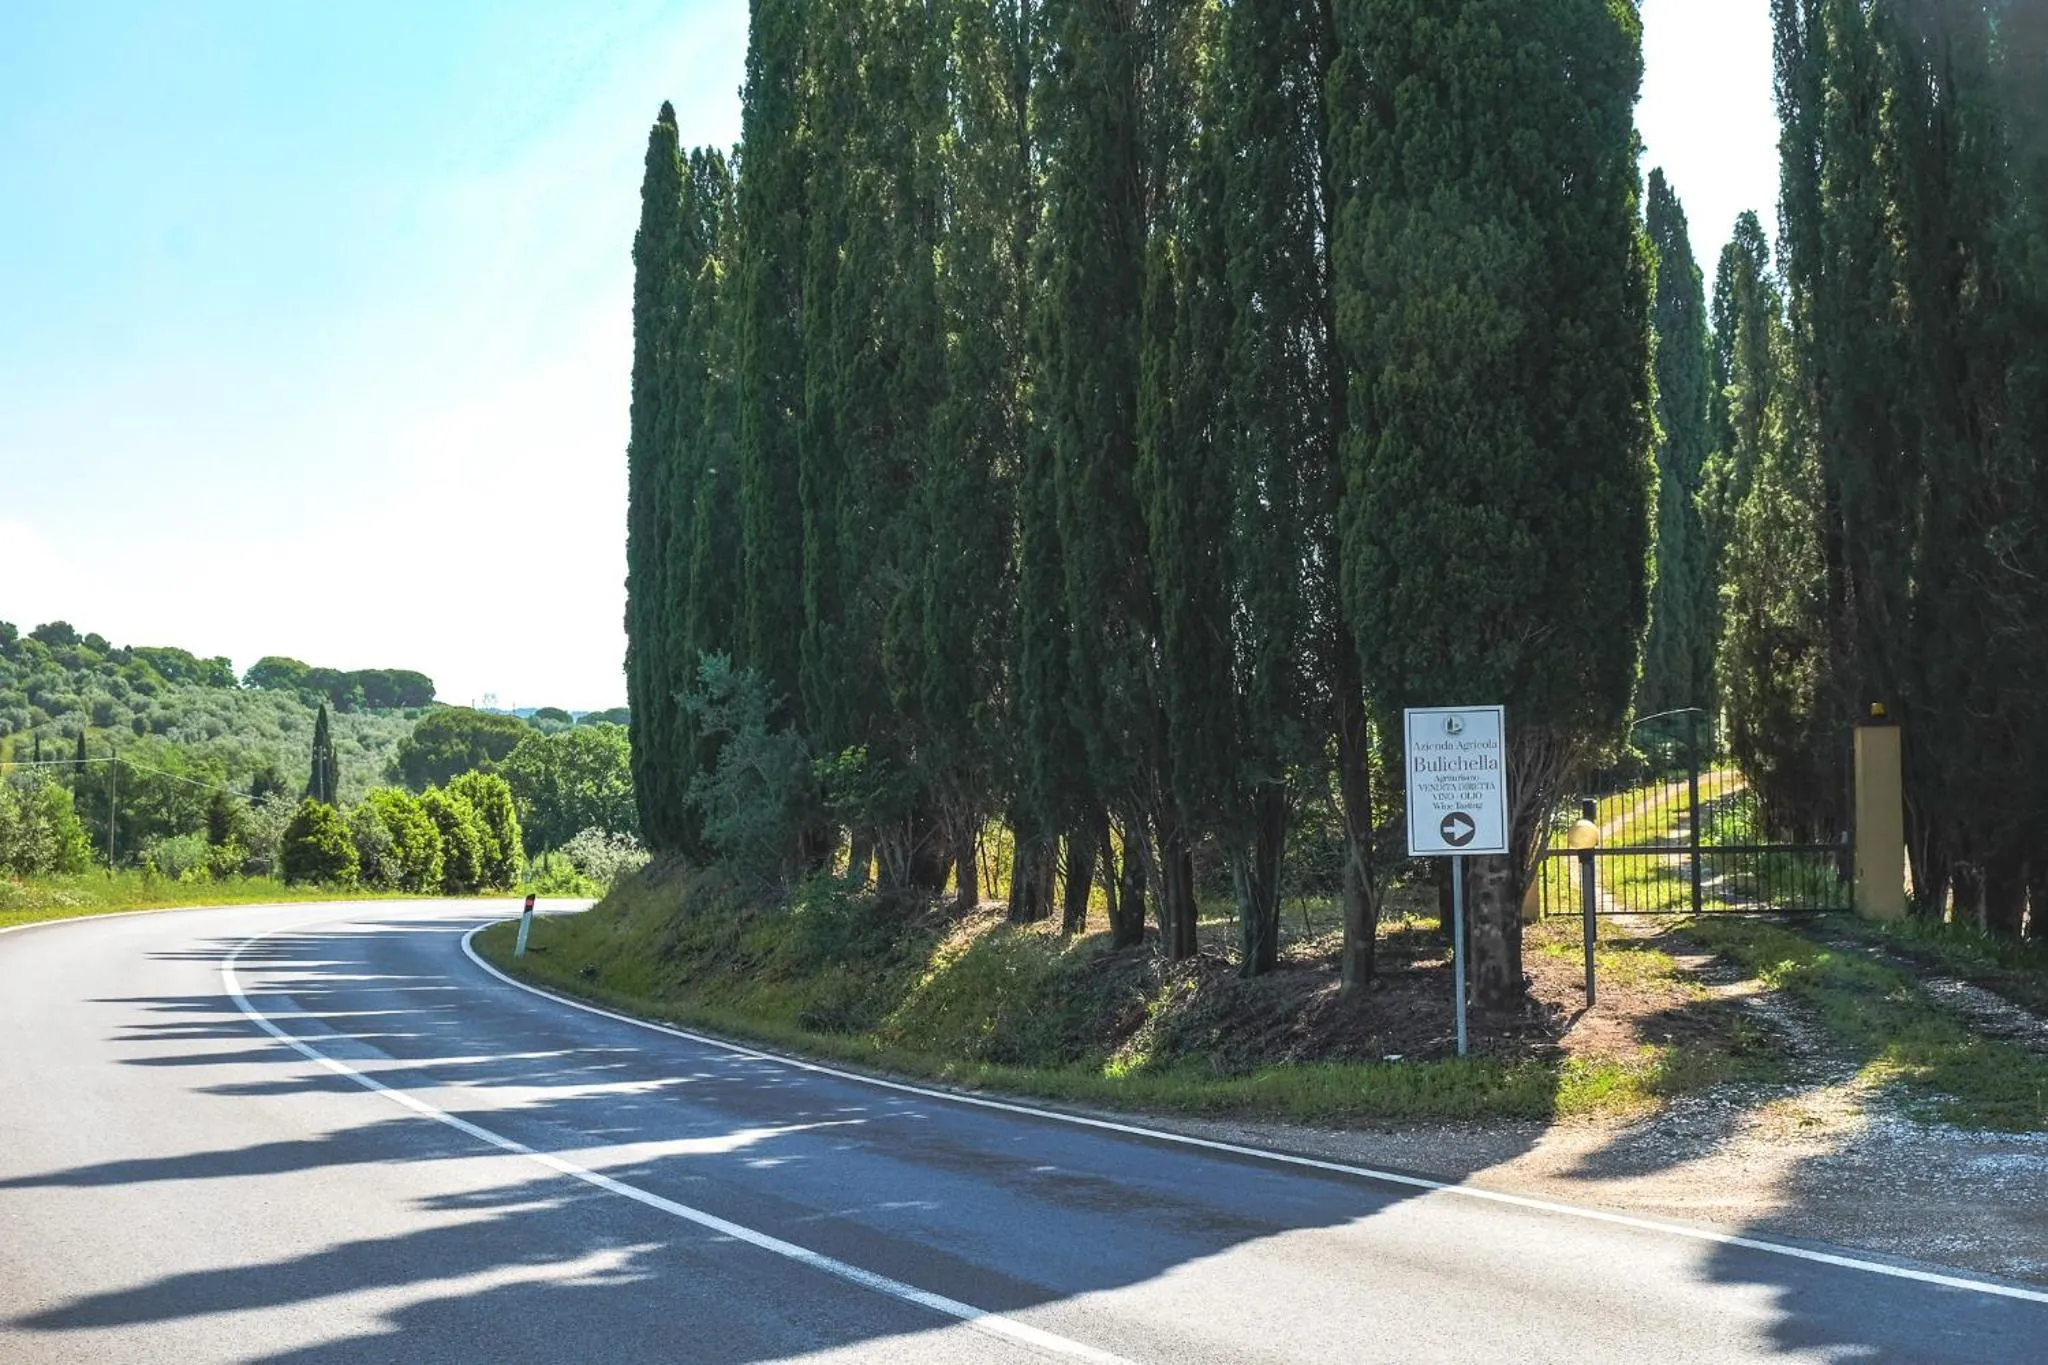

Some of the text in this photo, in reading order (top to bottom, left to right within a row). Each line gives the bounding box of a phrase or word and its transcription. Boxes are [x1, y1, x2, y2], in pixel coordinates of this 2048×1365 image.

[1414, 739, 1498, 751] Azienda Agricola
[1415, 755, 1498, 772] Bulichella
[1432, 792, 1482, 801] VINO OLIO
